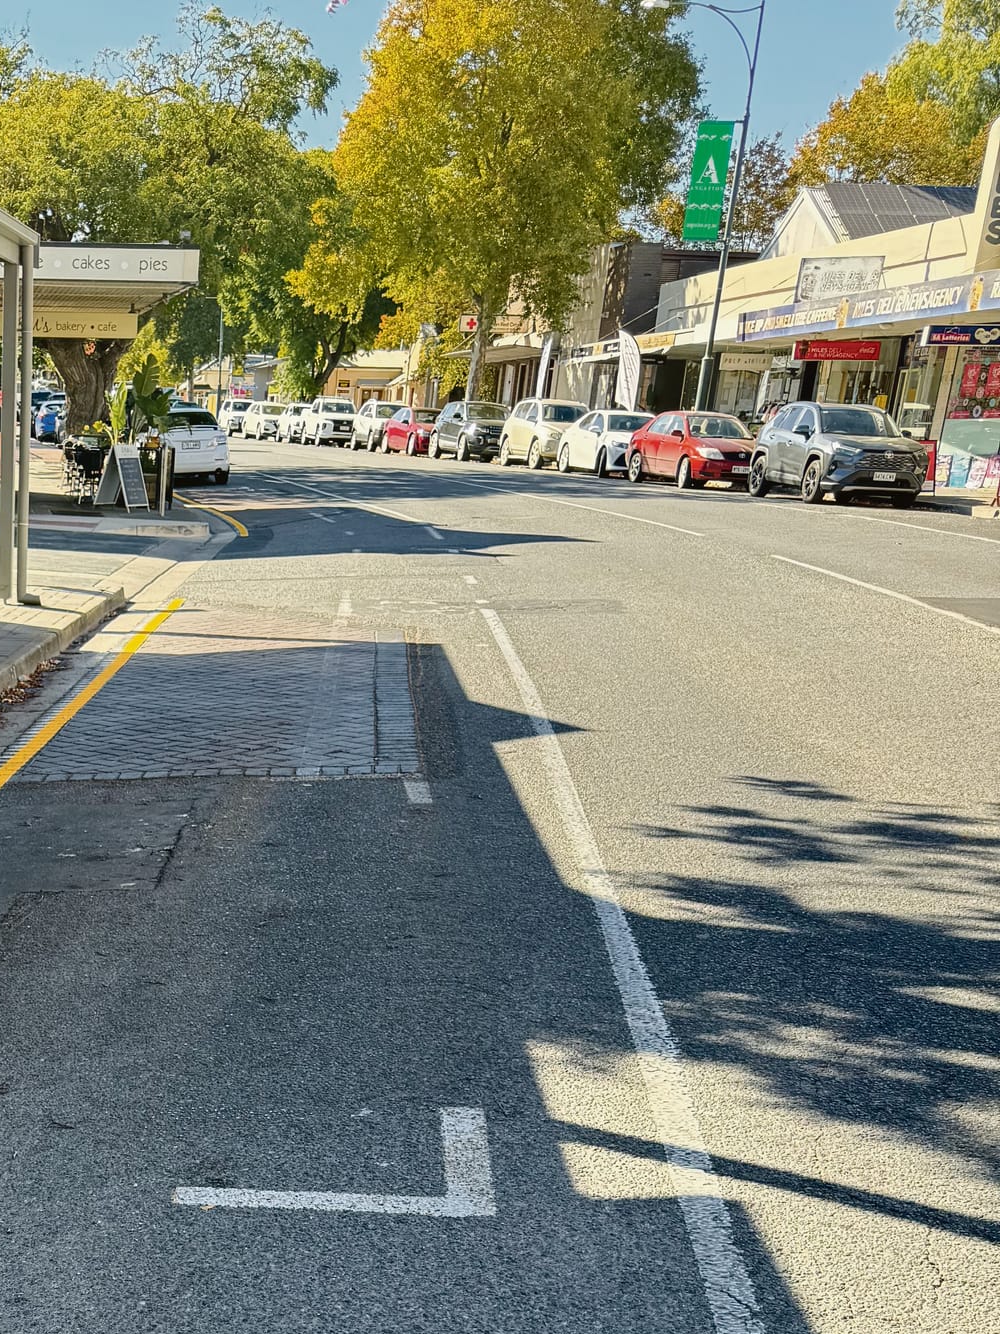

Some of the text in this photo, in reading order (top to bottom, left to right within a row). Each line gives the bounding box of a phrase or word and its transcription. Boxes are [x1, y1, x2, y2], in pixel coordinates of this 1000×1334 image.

[696, 155, 720, 184] A
[72, 255, 168, 274] cakes pies
[852, 300, 875, 319] MILES
[876, 298, 895, 316] DELI
[903, 286, 964, 312] NEWSAGENCY
[56, 320, 86, 333] bakery
[97, 321, 117, 332] cafe
